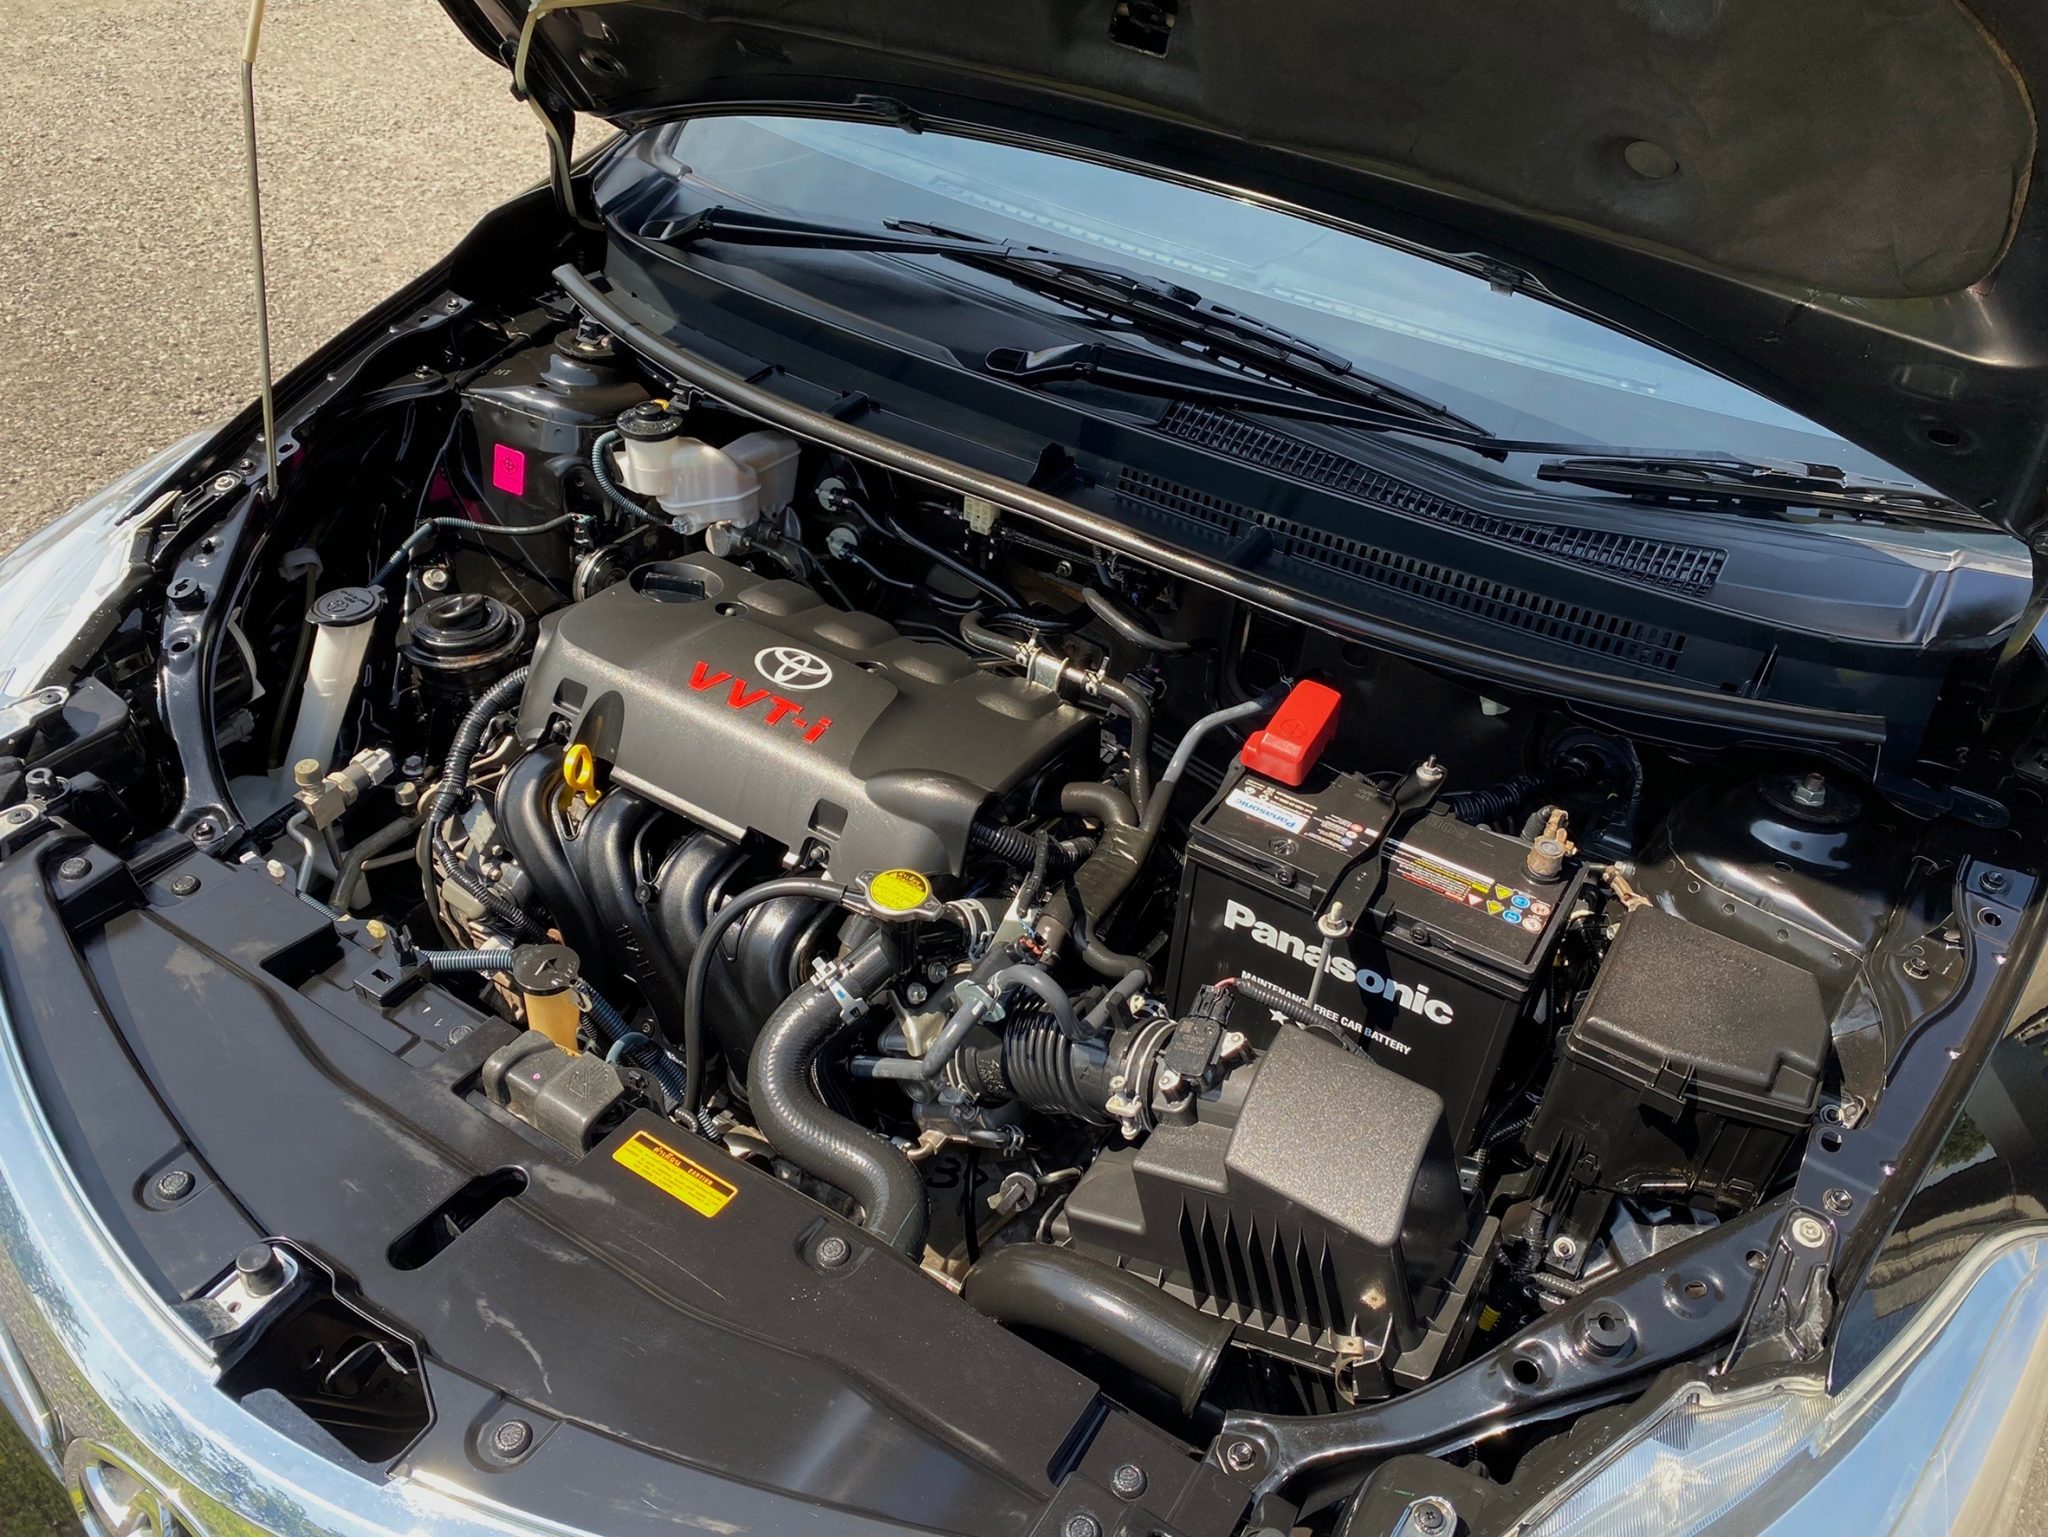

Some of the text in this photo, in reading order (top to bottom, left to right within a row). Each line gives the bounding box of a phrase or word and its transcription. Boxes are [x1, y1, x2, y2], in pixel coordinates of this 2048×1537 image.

[688, 660, 832, 744] VVT-i
[1235, 798, 1297, 829] Panasonic
[1223, 899, 1454, 1025] Panasonic
[1241, 970, 1412, 1056] MAINTENANC FREE CAR BATTERY
